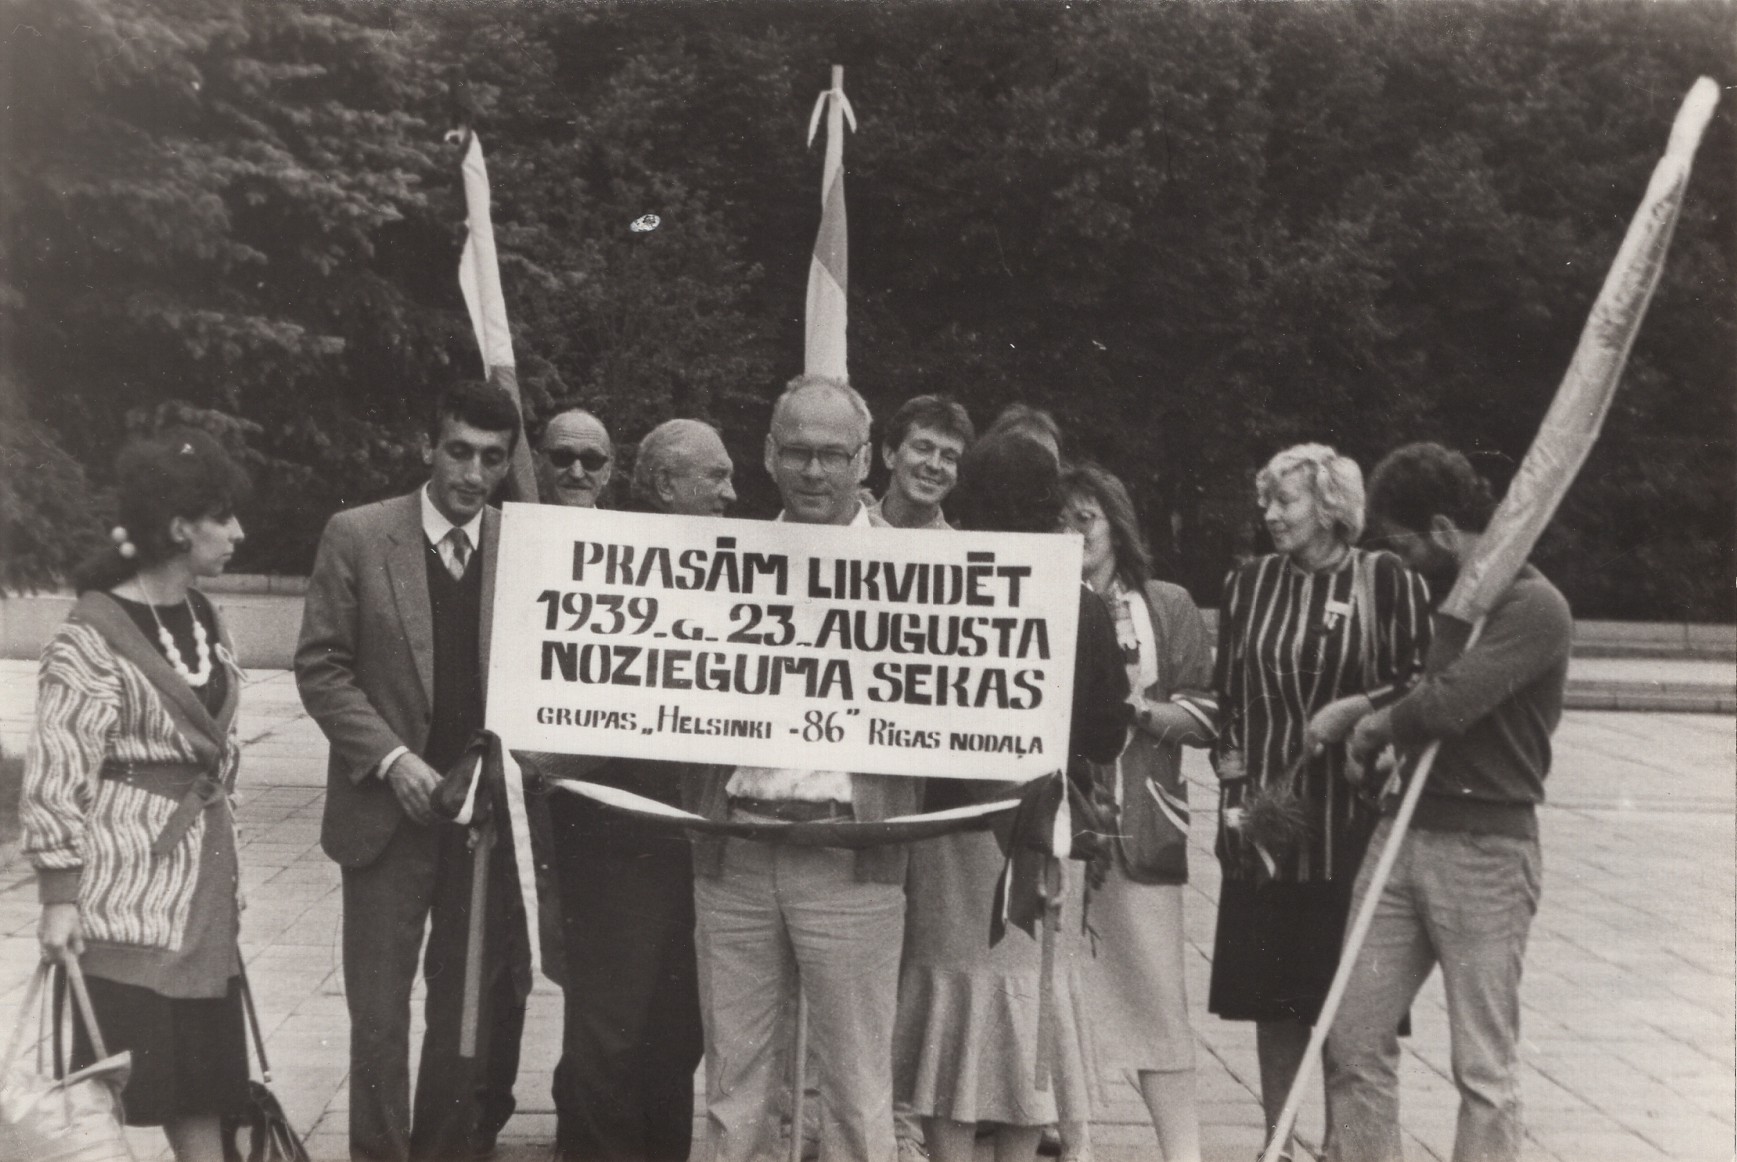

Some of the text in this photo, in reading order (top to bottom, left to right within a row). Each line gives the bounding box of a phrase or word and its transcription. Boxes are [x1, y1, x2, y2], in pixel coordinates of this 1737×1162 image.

[572, 536, 1032, 608] PRASĀM LIKVIDĒT
[814, 608, 1051, 660] AUGUSTA
[541, 641, 1045, 710] NOZIEGUMA SEKAS
[536, 706, 637, 731] GRUPAS
[950, 732, 1044, 759] NODAĻA
